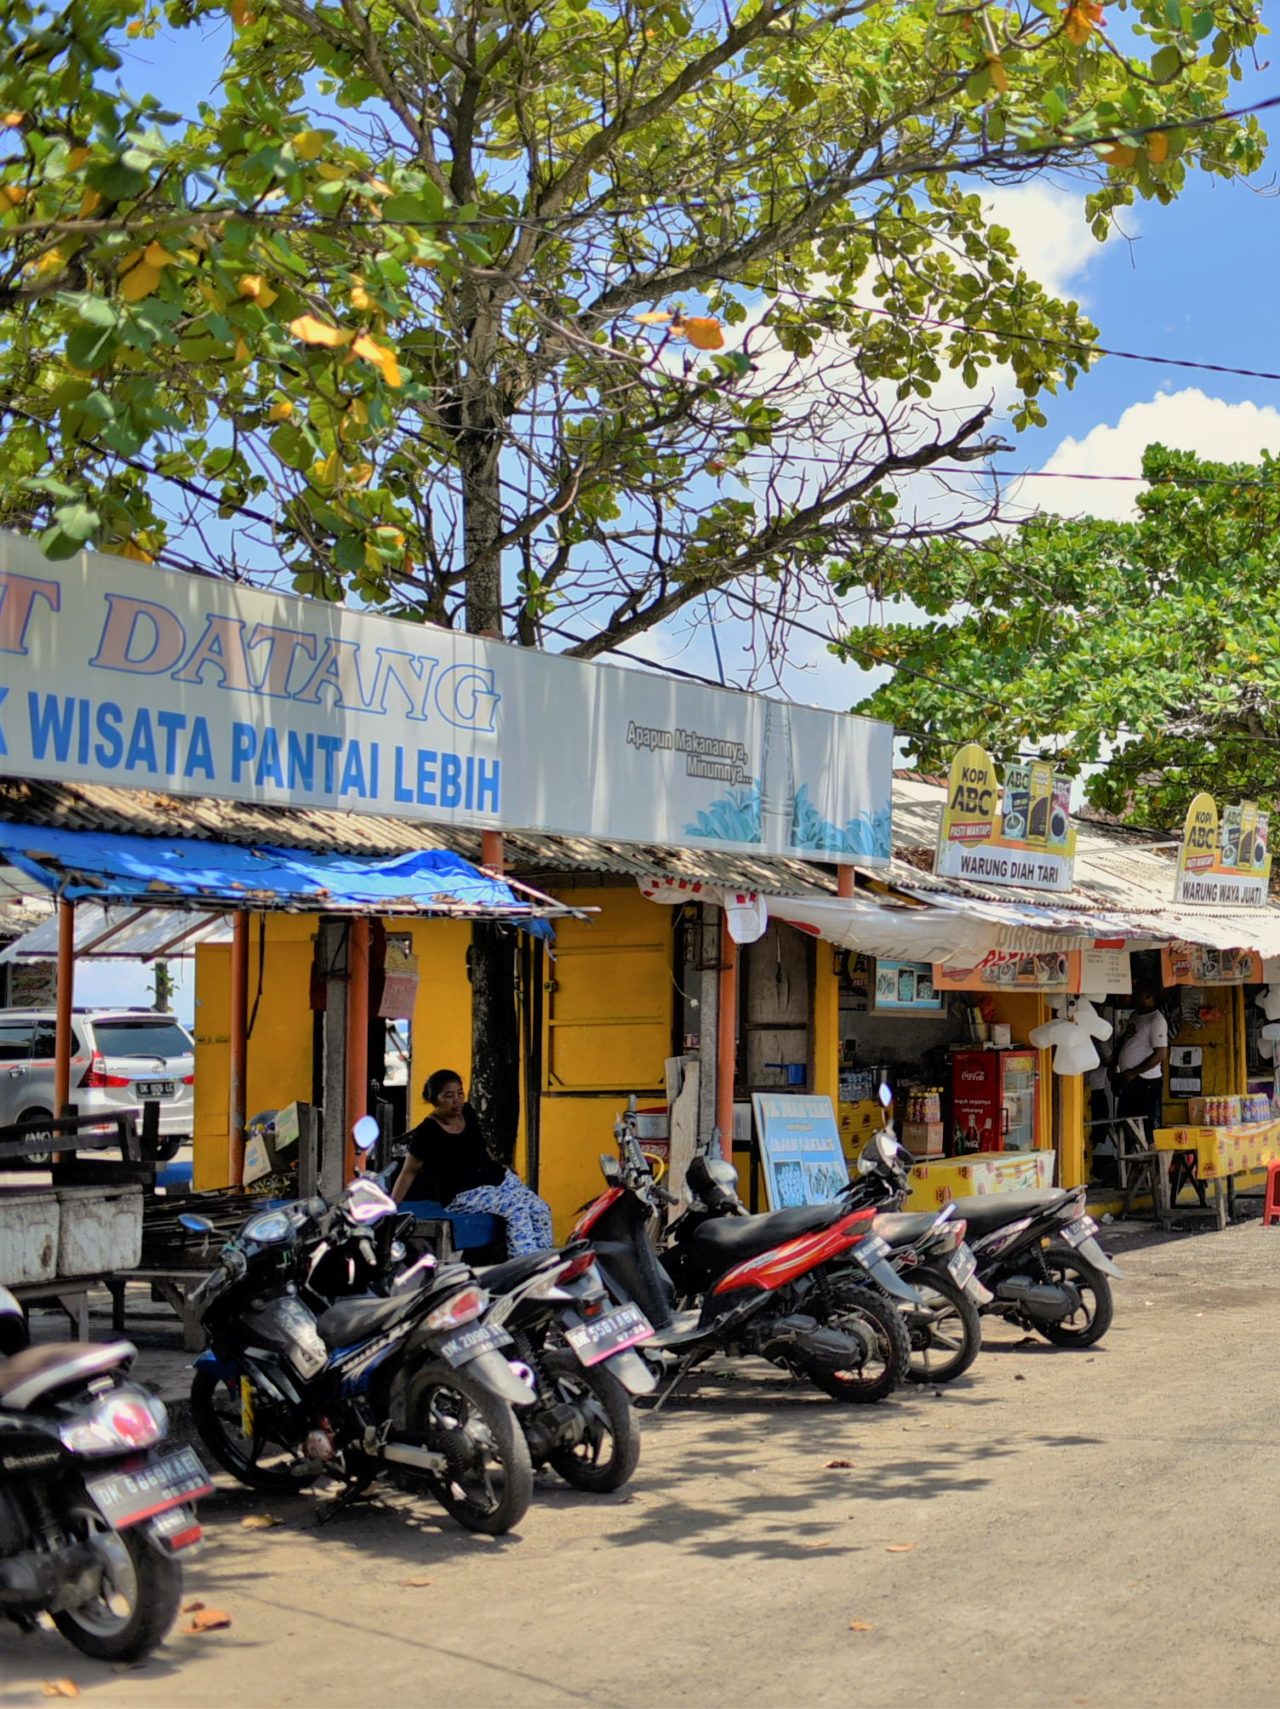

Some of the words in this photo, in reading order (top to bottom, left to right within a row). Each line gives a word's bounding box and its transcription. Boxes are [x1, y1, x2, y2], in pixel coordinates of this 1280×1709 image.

[89, 593, 501, 732] DATANG
[27, 691, 215, 781] WISATA
[231, 721, 379, 799] PANTAI
[394, 745, 500, 813] LEBIH
[626, 720, 672, 751] Apapun
[674, 728, 748, 765] Makanannya,
[686, 754, 753, 786] Minumnya...
[962, 767, 987, 785] KOPI
[1006, 771, 1029, 789] ABC
[950, 785, 992, 816] ABC
[1195, 811, 1212, 824] KOPI
[1187, 826, 1215, 849] ABC
[961, 855, 1007, 877] WARUNG
[1010, 861, 1034, 880] DIAH
[1038, 864, 1058, 883] TARI
[1183, 881, 1217, 901] WARUNG
